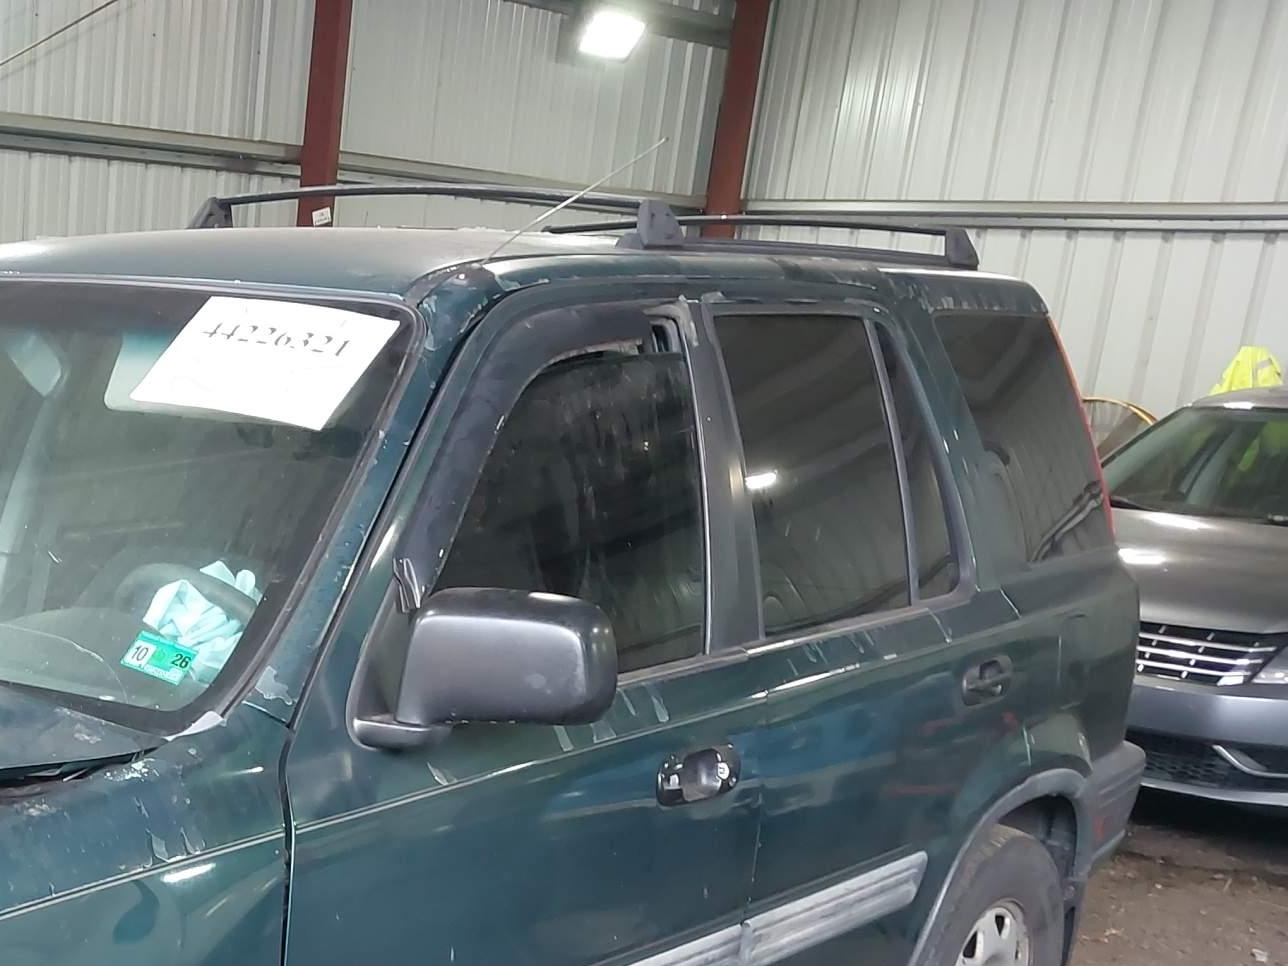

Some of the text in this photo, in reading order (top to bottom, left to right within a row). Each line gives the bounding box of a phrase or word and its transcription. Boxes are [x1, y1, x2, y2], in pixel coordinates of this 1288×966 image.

[203, 322, 350, 356] 44226321
[131, 645, 192, 669] 10 26
